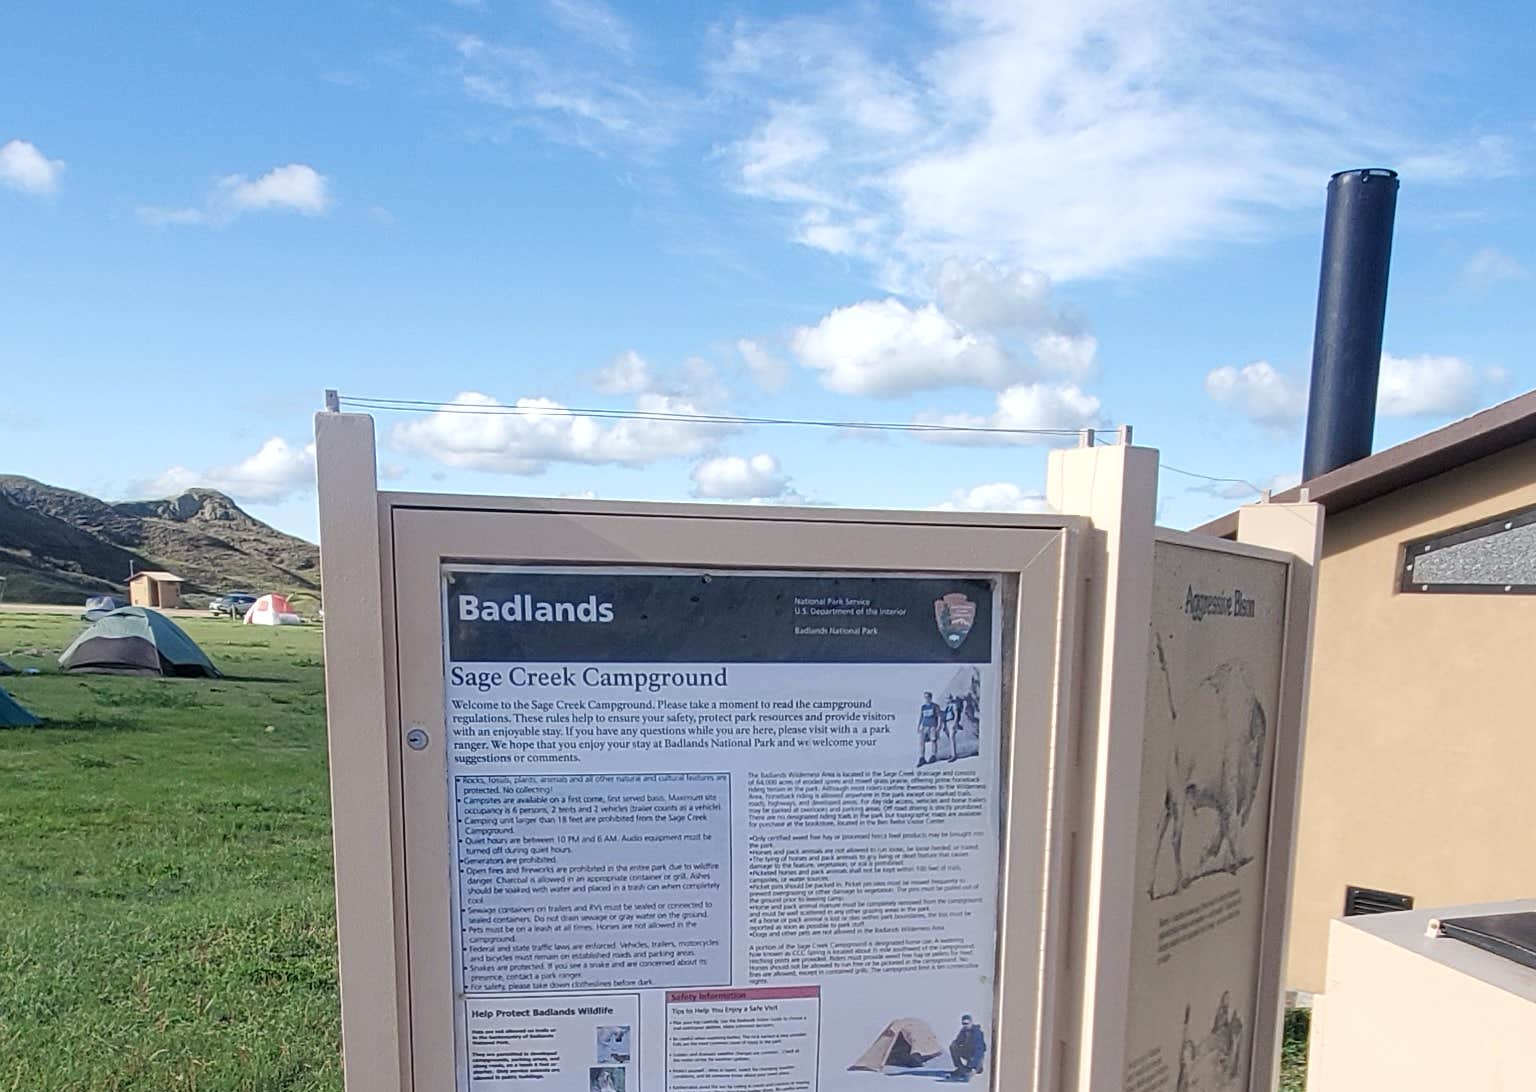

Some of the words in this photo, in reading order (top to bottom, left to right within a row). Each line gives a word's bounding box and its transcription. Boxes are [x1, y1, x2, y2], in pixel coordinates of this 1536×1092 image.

[827, 598, 843, 606] Park
[458, 594, 614, 624] Badlands
[794, 607, 807, 615] U.S.
[810, 607, 854, 618] Department
[855, 608, 863, 616] of
[865, 608, 877, 616] the
[879, 608, 906, 616] Interior
[795, 627, 827, 635] Badlands
[829, 627, 860, 635] National
[861, 627, 878, 635] Park
[452, 666, 502, 692] Sage
[509, 667, 576, 687] Creek
[583, 667, 728, 692] Campground
[452, 699, 498, 709] Welcome
[500, 699, 511, 709] to
[513, 699, 529, 709] the
[531, 699, 553, 713] Sage
[556, 699, 585, 709] Creek
[587, 698, 655, 713] Campground.
[657, 698, 687, 709] Please
[689, 698, 709, 709] take
[719, 698, 758, 709] moment
[760, 698, 770, 709] to
[772, 698, 793, 709] read
[795, 698, 810, 709] the
[812, 698, 872, 712] campground
[453, 712, 512, 726] regulations.
[515, 712, 542, 722] These
[545, 712, 569, 722] rules
[571, 712, 593, 726] help
[595, 711, 605, 722] to
[642, 714, 664, 725] your
[666, 711, 696, 725] safety,
[698, 711, 731, 725] protect
[734, 711, 755, 725] park
[805, 711, 822, 721] and
[825, 710, 860, 725] provide
[862, 710, 895, 721] visitors
[453, 725, 475, 736] with
[492, 725, 539, 739] enjoyable
[542, 725, 563, 739] stay.
[565, 725, 572, 735] If
[575, 728, 593, 739] you
[595, 725, 618, 735] have
[620, 728, 637, 739] any
[639, 724, 685, 739] questions
[688, 724, 713, 735] while
[716, 727, 733, 738] you
[752, 724, 776, 736] here,
[778, 724, 806, 738] please
[809, 724, 827, 734] visit
[830, 723, 850, 734] with
[869, 723, 890, 737] park
[454, 742, 488, 753] ranger.
[491, 738, 506, 749] We
[509, 738, 534, 753] hope
[536, 738, 555, 749] that
[558, 741, 576, 752] you
[578, 741, 604, 752] enjoy
[607, 741, 629, 752] your
[632, 738, 650, 752] stay
[653, 737, 661, 748] at
[664, 737, 708, 748] Badlands
[711, 737, 751, 748] National
[754, 737, 774, 747] Park
[777, 736, 795, 747] and
[812, 736, 853, 747] welcome
[855, 739, 876, 750] your
[454, 752, 511, 766] suggestions
[526, 752, 581, 762] comments.
[463, 786, 500, 796] protected.
[515, 785, 553, 796] collecting!
[464, 856, 503, 864] Generators
[671, 993, 696, 1002] Safety
[472, 1009, 493, 1019] Help
[495, 1008, 529, 1017] Protect
[532, 1008, 575, 1016] Badlands
[578, 1007, 613, 1015] Wildlife
